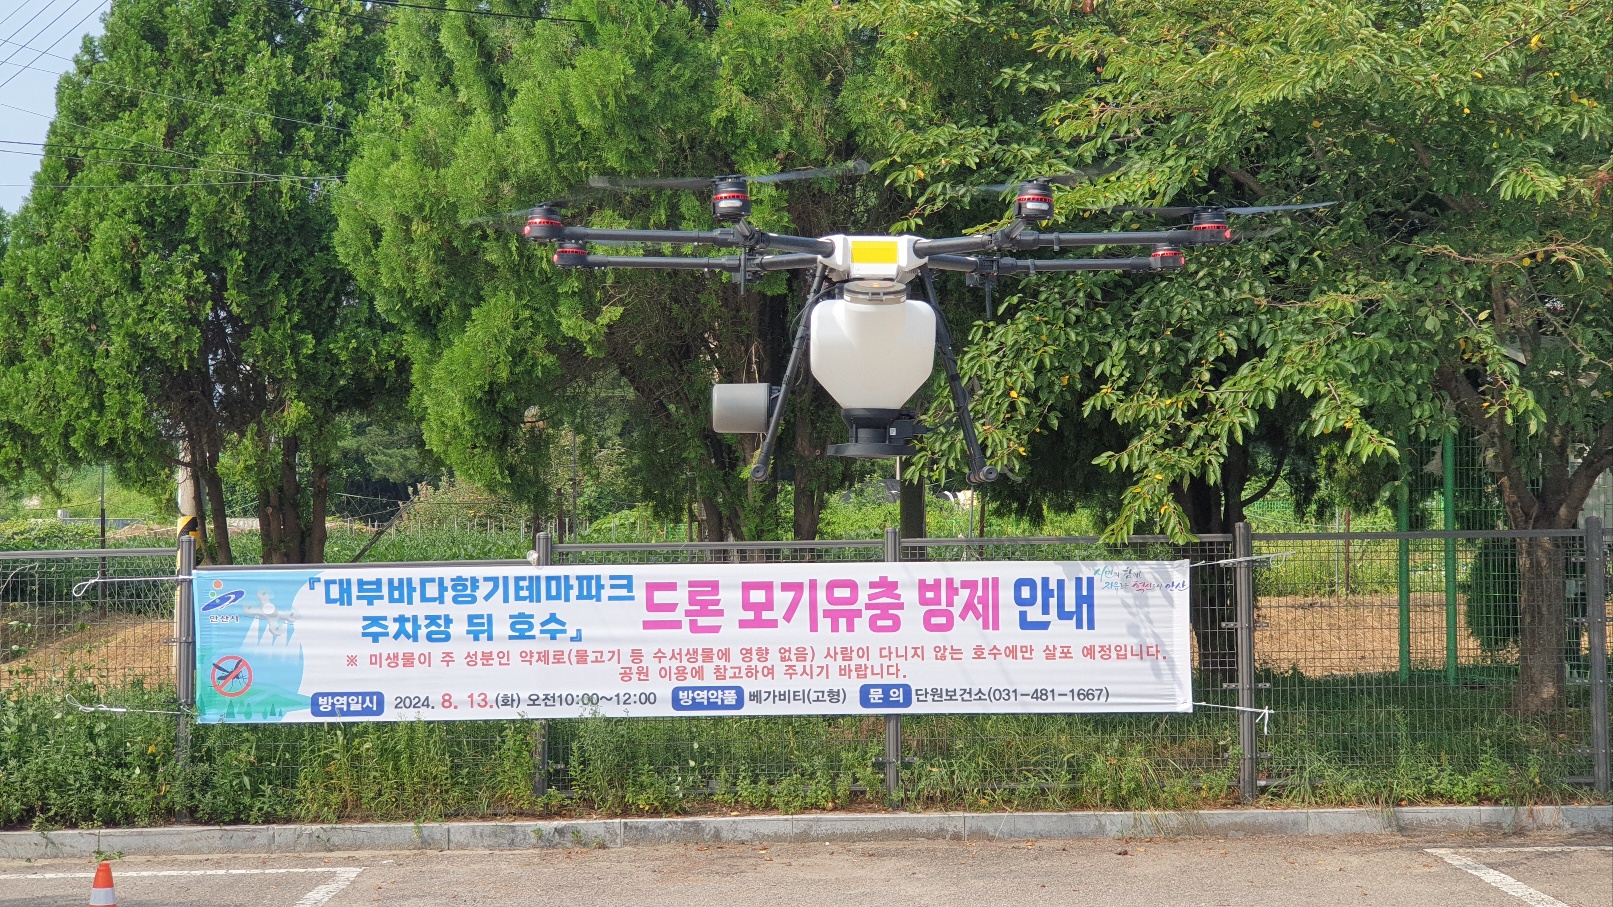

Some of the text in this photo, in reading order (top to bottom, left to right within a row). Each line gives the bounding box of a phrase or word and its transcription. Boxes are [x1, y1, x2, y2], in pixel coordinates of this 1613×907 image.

[1165, 580, 1189, 592] 안산
[642, 575, 1096, 634] 드론 모기유충 방제 안내
[209, 614, 239, 623] 안산시
[361, 611, 582, 644] 주차장 뒤 호수』
[369, 651, 432, 668] 미생물이
[440, 651, 456, 668] 주
[464, 650, 511, 667] 성분인
[519, 649, 621, 666] 약제로(물고기
[630, 648, 645, 664] 등
[653, 647, 731, 664] 수서생물에
[739, 646, 770, 663] 영향
[778, 645, 816, 663] 없음)
[824, 645, 870, 662] 사람이
[879, 645, 925, 662] 다니지
[933, 644, 963, 661] 않는
[972, 644, 1034, 661] 호수에만
[1043, 644, 1073, 661] 살포
[1082, 643, 1167, 661] 예정입니다.
[619, 663, 908, 682] 공원 이용에 참고하여 주시기 바랍니다.
[394, 695, 436, 710] 2024.
[441, 692, 458, 709] 8.
[678, 689, 738, 706] 방역약품
[748, 687, 847, 705] 베가비티(고형)
[868, 687, 904, 703] 문 의
[915, 686, 1109, 703] 단원보건소(031-481-1667)
[318, 695, 377, 712] 방역일시
